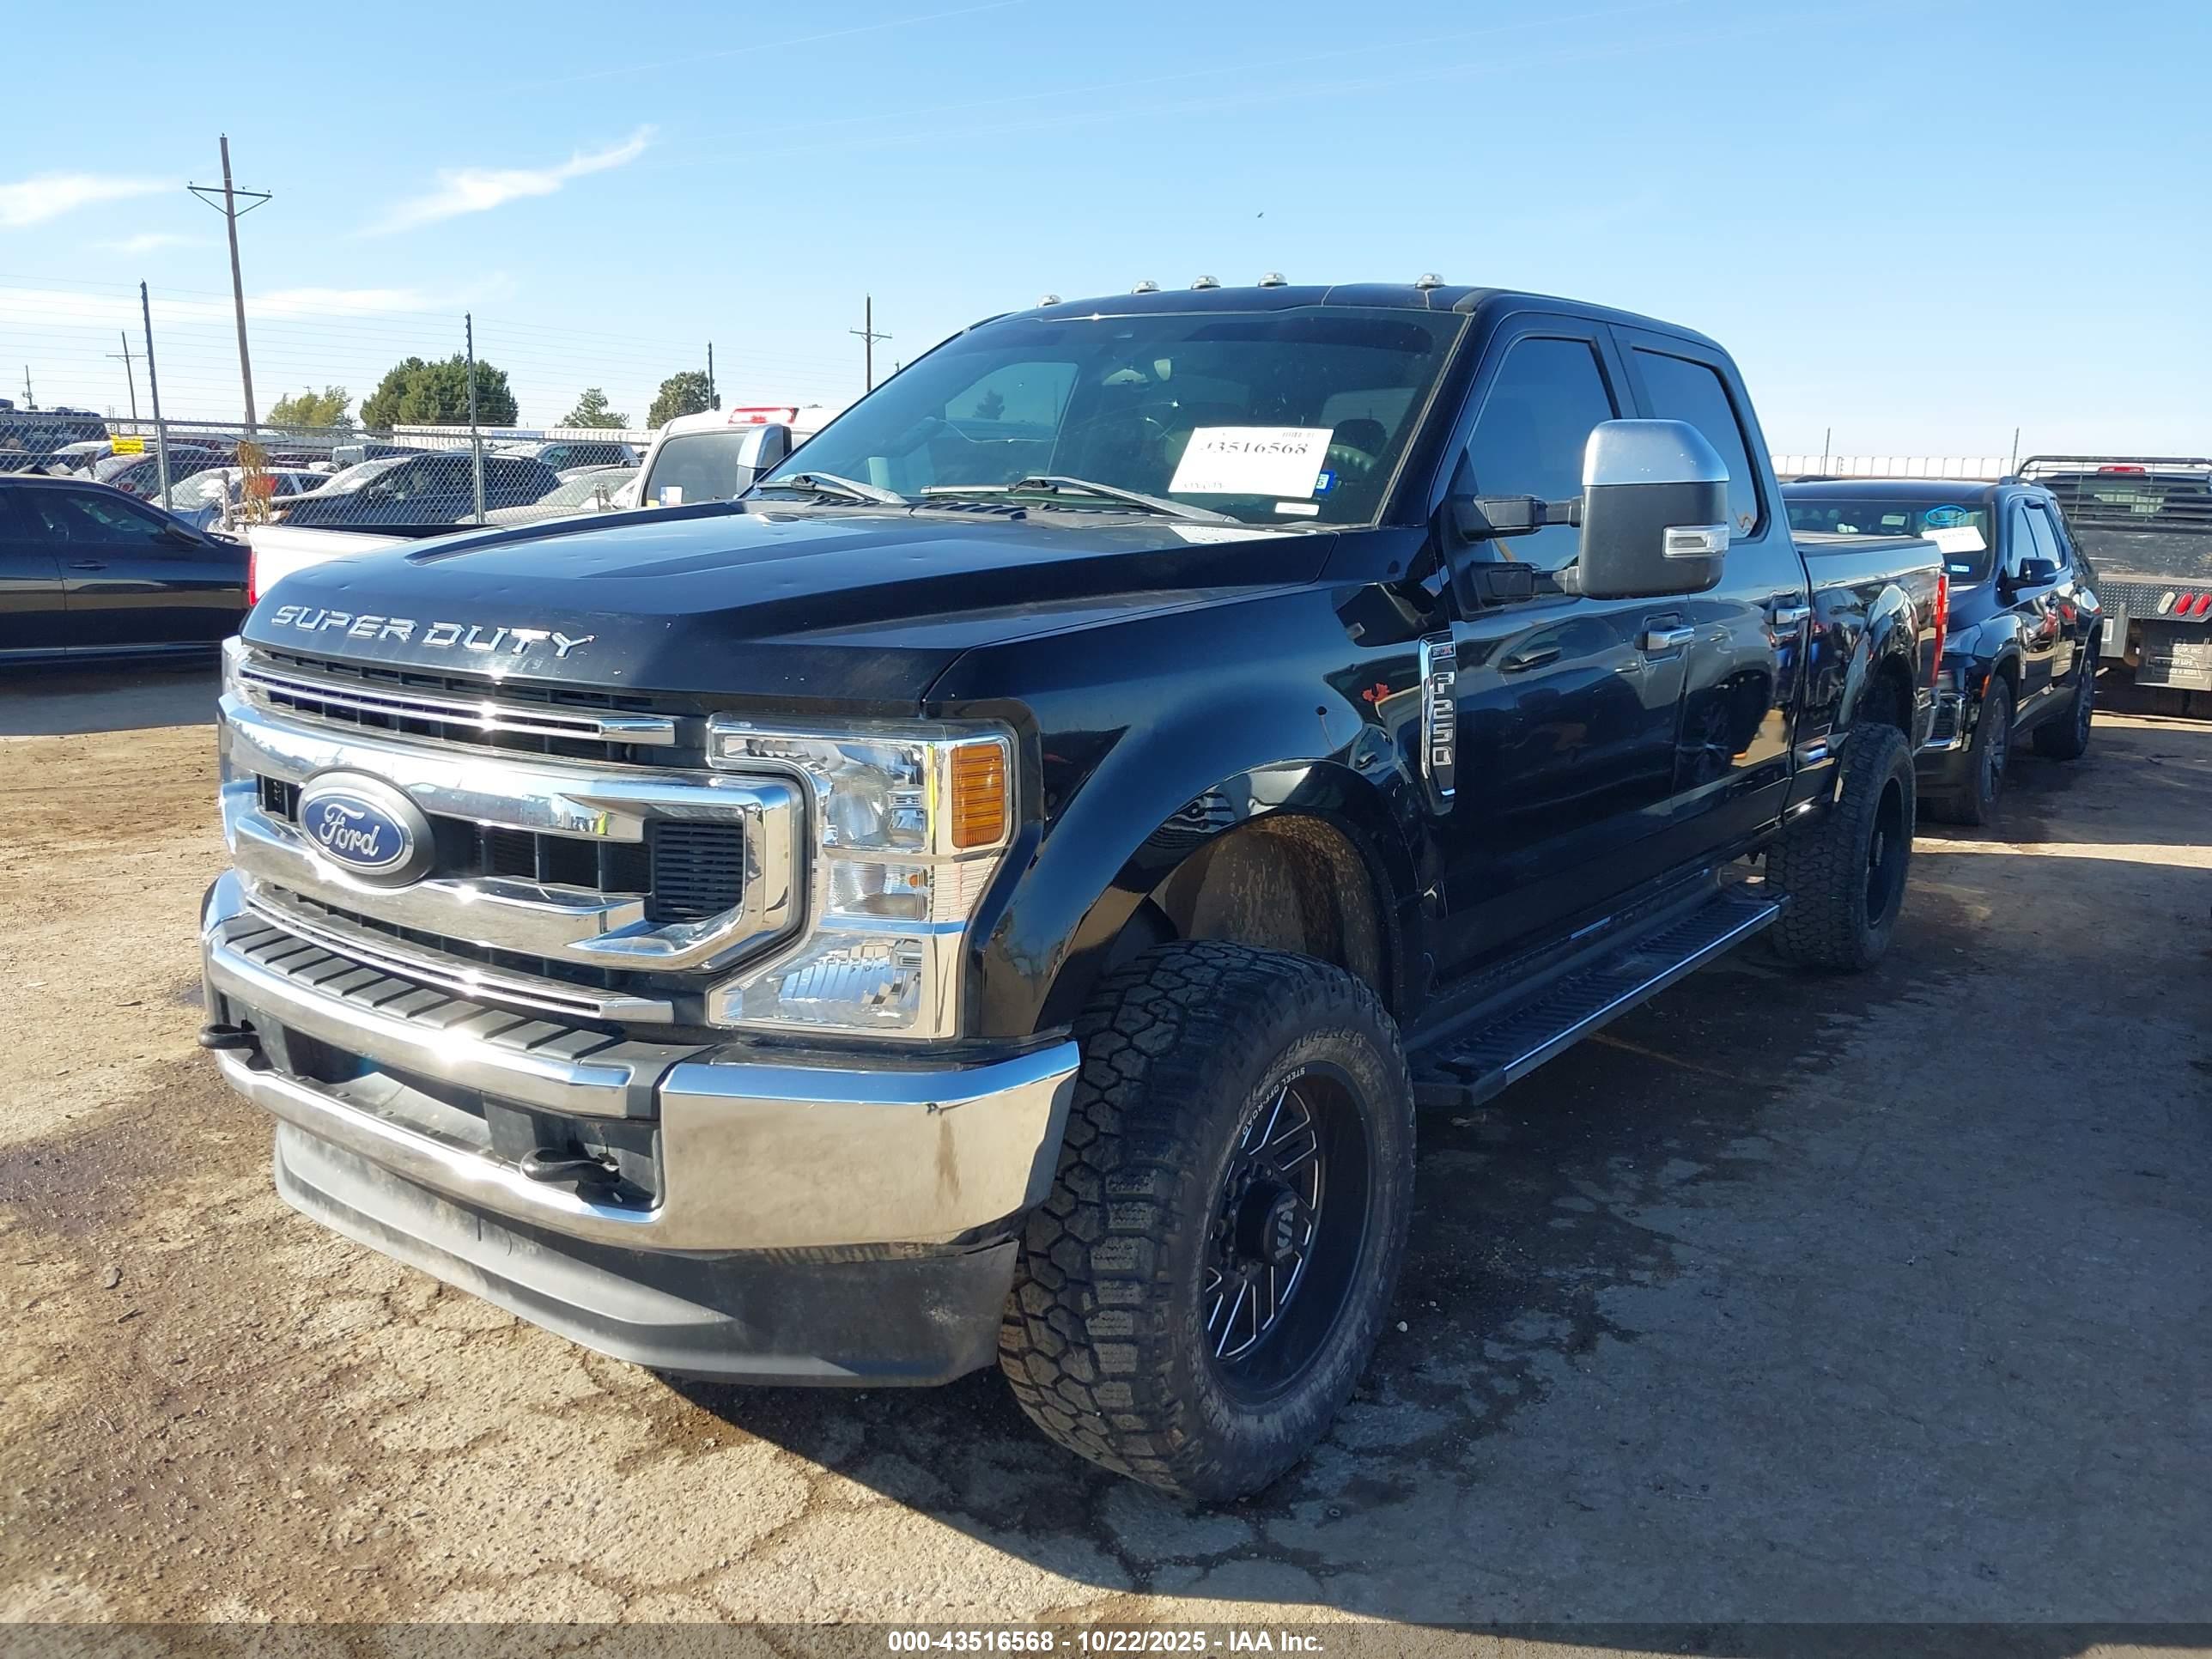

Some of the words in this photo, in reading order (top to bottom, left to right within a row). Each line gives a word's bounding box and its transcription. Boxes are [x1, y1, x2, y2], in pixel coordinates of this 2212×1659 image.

[271, 605, 417, 641] SUPER
[422, 622, 599, 659] DUTY
[319, 803, 380, 857] Ford
[1281, 1066, 1306, 1085] STEEL
[1243, 1085, 1279, 1135] OFF-ROAD
